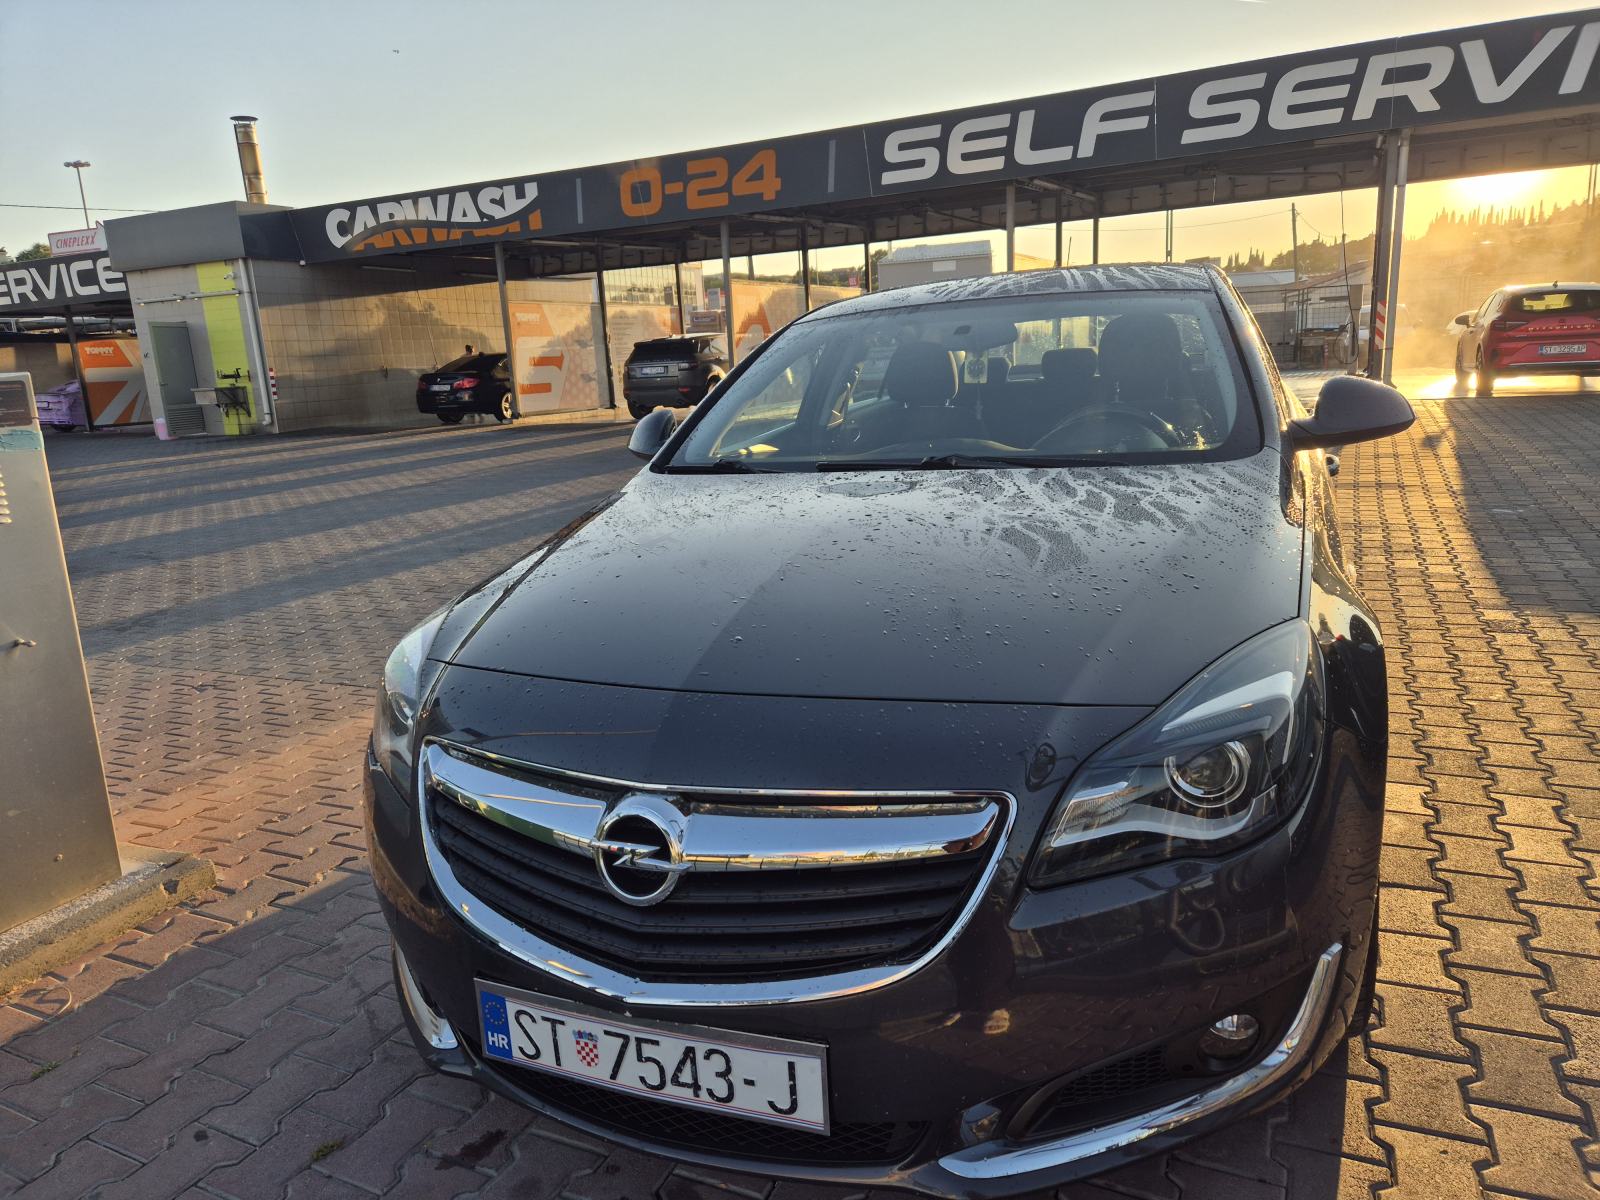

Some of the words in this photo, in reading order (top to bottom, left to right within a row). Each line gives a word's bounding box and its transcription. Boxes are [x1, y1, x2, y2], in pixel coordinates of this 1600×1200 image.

[881, 90, 1156, 186] SELF
[1180, 21, 1600, 145] SERVI
[619, 149, 782, 217] 0-24
[56, 232, 97, 249] CINEPLEXX
[487, 1031, 510, 1050] HR
[514, 1009, 565, 1067] ST
[603, 1029, 798, 1115] 7543-J
